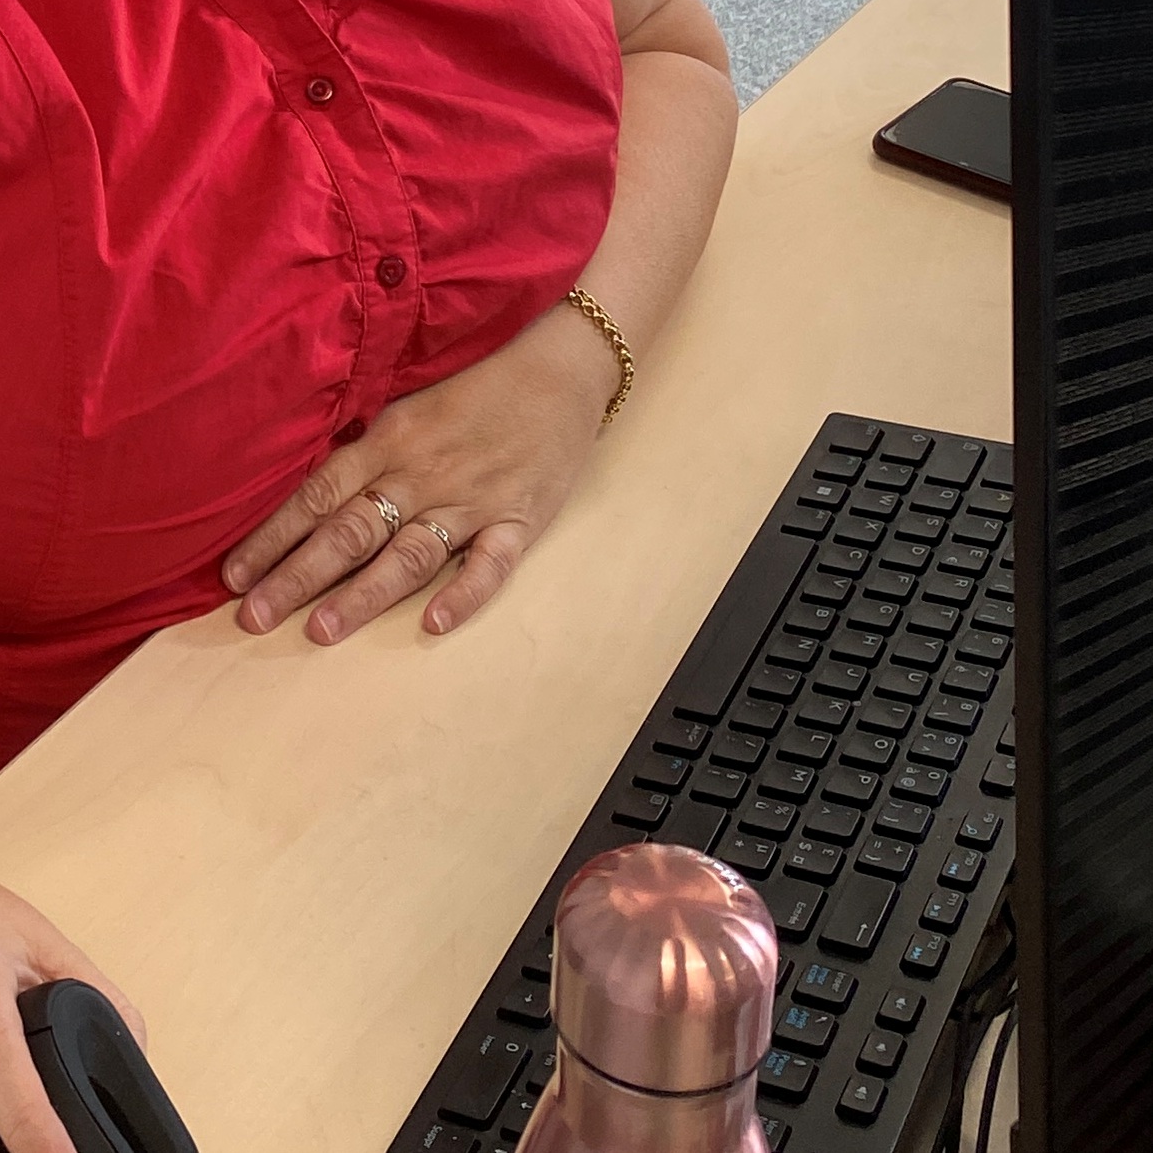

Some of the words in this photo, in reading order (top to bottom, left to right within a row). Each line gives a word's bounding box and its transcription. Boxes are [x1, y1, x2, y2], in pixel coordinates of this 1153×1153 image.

[939, 490, 954, 499] Q
[996, 493, 1010, 501] A
[879, 494, 895, 506] W
[865, 521, 879, 531] X
[926, 518, 939, 526] S
[984, 520, 998, 530] Z
[849, 550, 863, 559] C
[911, 546, 926, 555] D
[969, 549, 983, 557] E
[833, 579, 847, 588] V
[898, 575, 910, 584] F
[954, 578, 969, 587] R
[816, 609, 829, 617] B
[880, 605, 893, 614] G
[940, 610, 954, 619] T
[798, 639, 813, 649] N
[862, 635, 879, 645] H
[991, 637, 1004, 645] 6
[924, 641, 939, 649] Y
[847, 668, 859, 677] J
[908, 672, 923, 682] U
[828, 700, 844, 711] K
[960, 703, 973, 711] 8
[810, 734, 826, 742] L
[944, 736, 957, 746] 9
[874, 739, 889, 749] O
[791, 768, 808, 782] M
[858, 774, 872, 784] P
[774, 806, 790, 815] %
[798, 842, 812, 852] $
[947, 892, 960, 906] F11
[927, 934, 941, 950] F12
